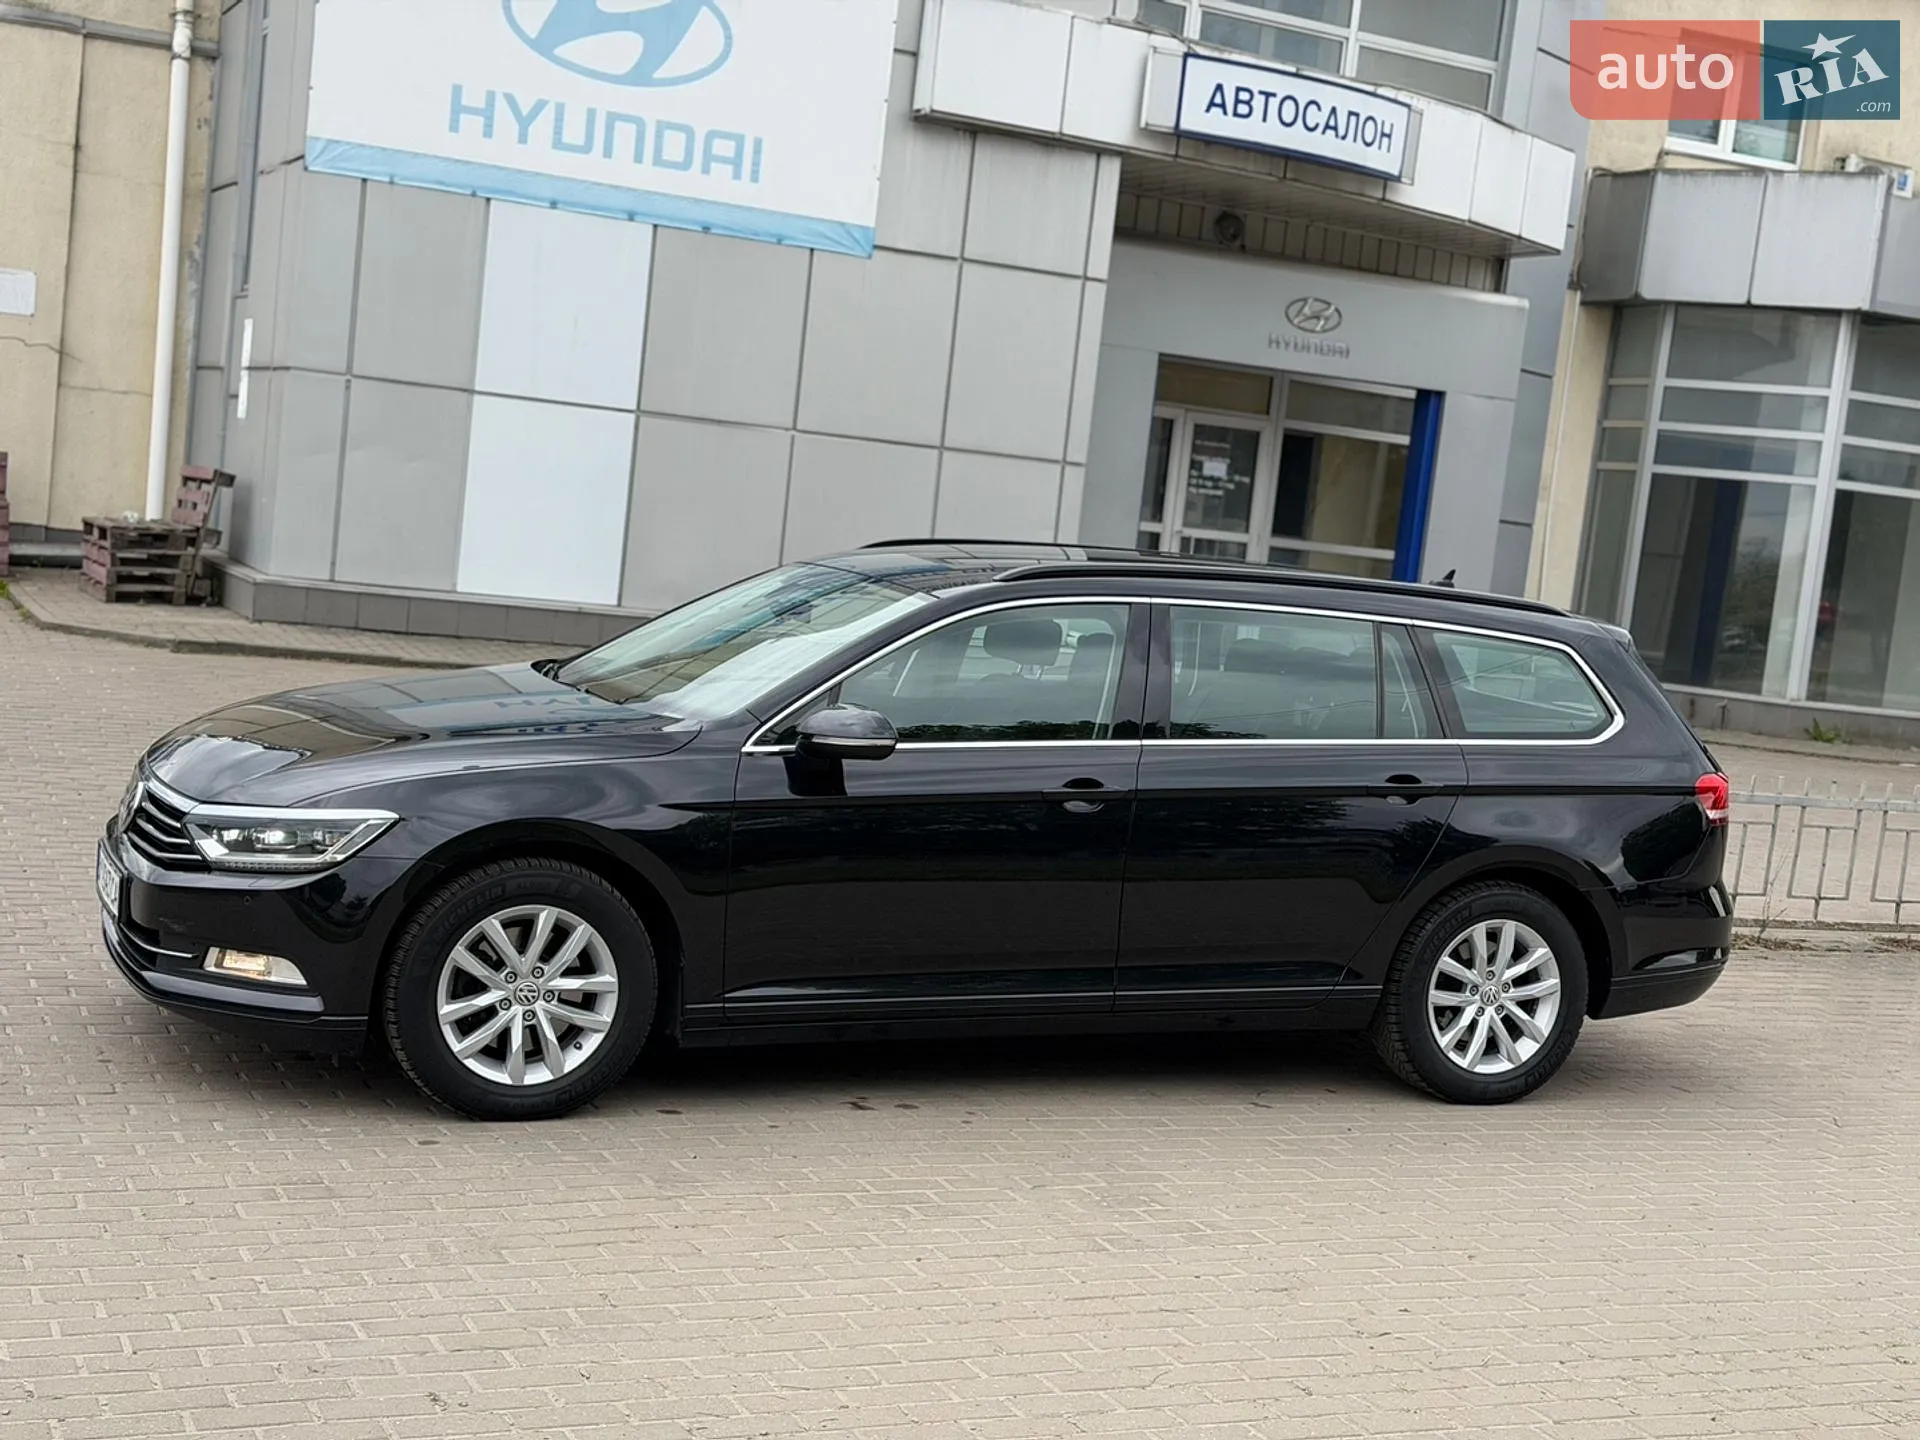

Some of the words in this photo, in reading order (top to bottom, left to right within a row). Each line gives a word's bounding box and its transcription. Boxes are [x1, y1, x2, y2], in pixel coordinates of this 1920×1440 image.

[448, 84, 764, 185] HYUNDAI
[1204, 82, 1394, 153] АВТОСАЛОН
[1267, 332, 1350, 360] HYUNDAI
